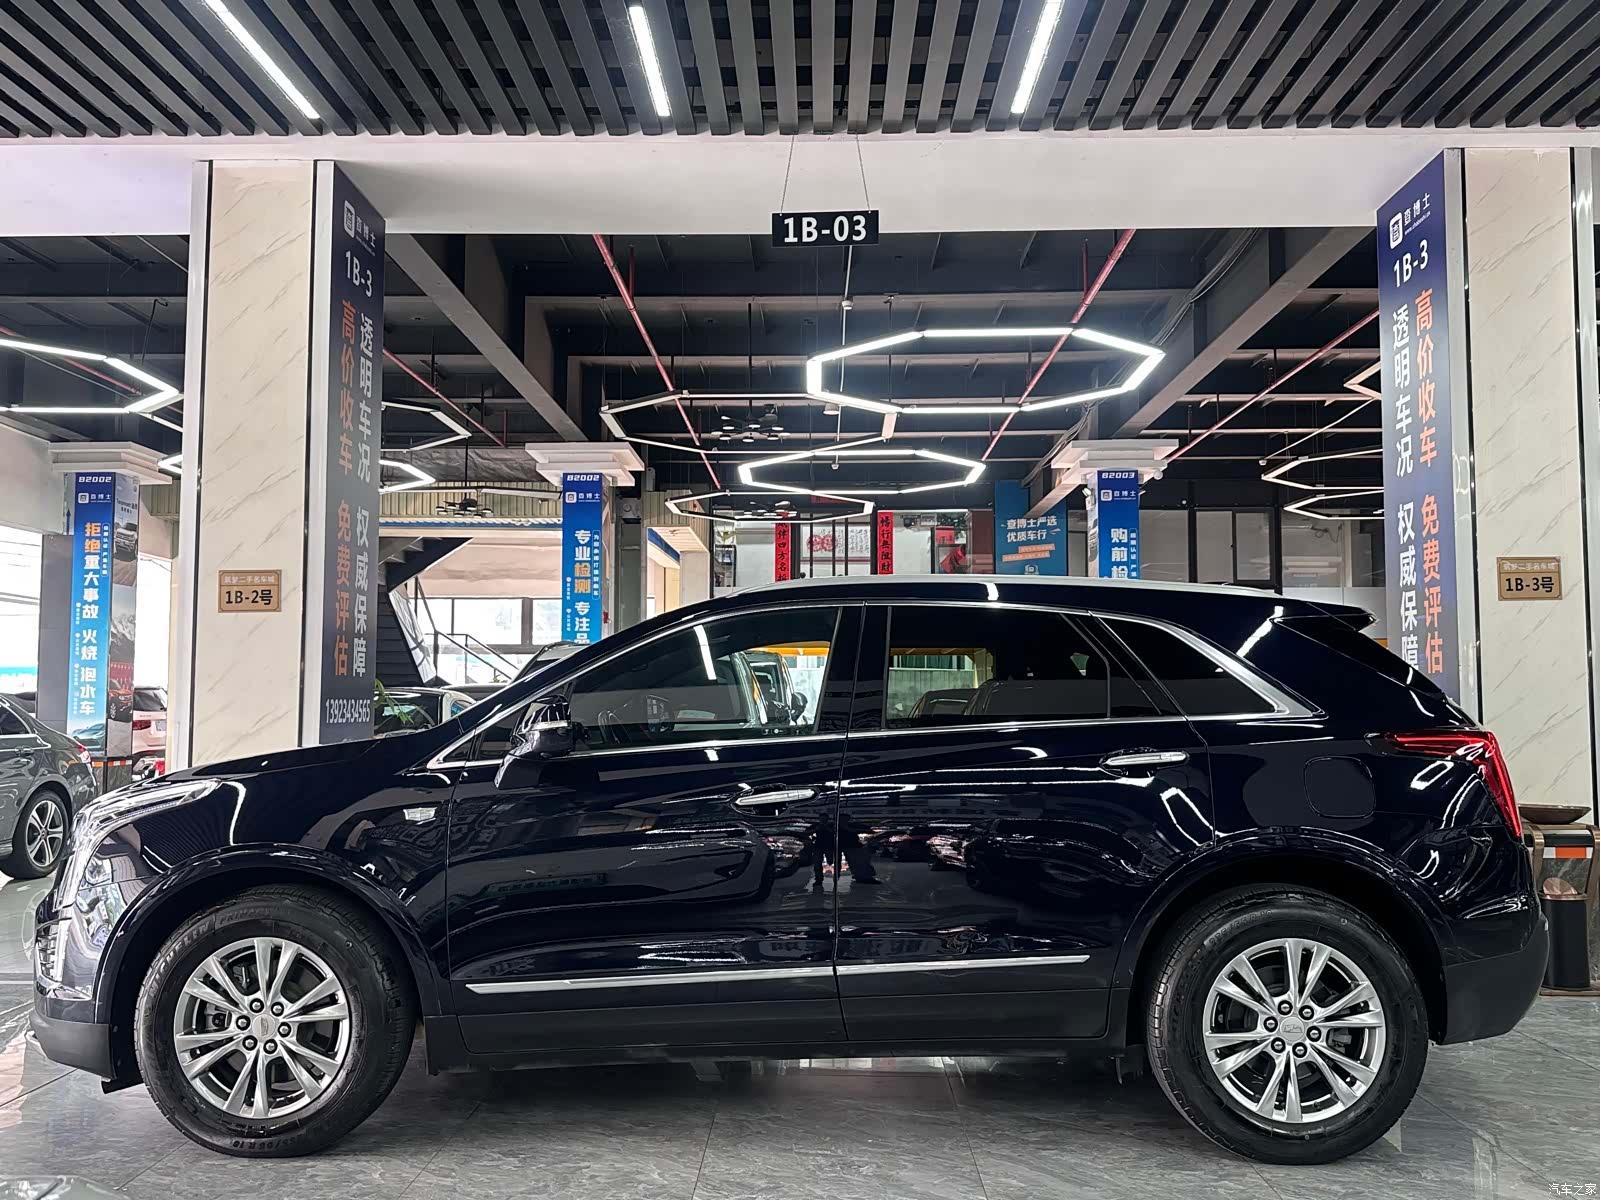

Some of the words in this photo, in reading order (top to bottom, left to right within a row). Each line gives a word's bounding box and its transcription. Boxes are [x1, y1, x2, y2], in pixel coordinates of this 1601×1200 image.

[784, 215, 867, 242] 1B-03
[345, 250, 373, 297] 1B-3
[1393, 239, 1429, 288] 1B-3
[338, 299, 356, 475] 高价收车
[357, 313, 373, 484] 透明车况
[1392, 304, 1413, 477] 透明车况
[1415, 288, 1438, 468] 高价收车
[1007, 515, 1057, 530] 查博士严选
[1007, 529, 1047, 542] 优质车行
[82, 522, 101, 619] 拒绝重大事故
[574, 530, 591, 593] 专业检测
[1111, 528, 1128, 578] 购前检
[225, 589, 273, 605] 1B-2号
[335, 499, 351, 676] 免费评估
[352, 506, 369, 677] 权威保障
[1398, 501, 1418, 670] 权威保障
[1420, 494, 1443, 674] 免费评估
[1505, 576, 1554, 593] 1B-3号
[81, 629, 97, 660] 火烧
[574, 601, 590, 644] 专注品
[79, 667, 96, 715] 泡水车
[325, 698, 371, 724] 13923434565
[149, 919, 211, 998] MICHELIN
